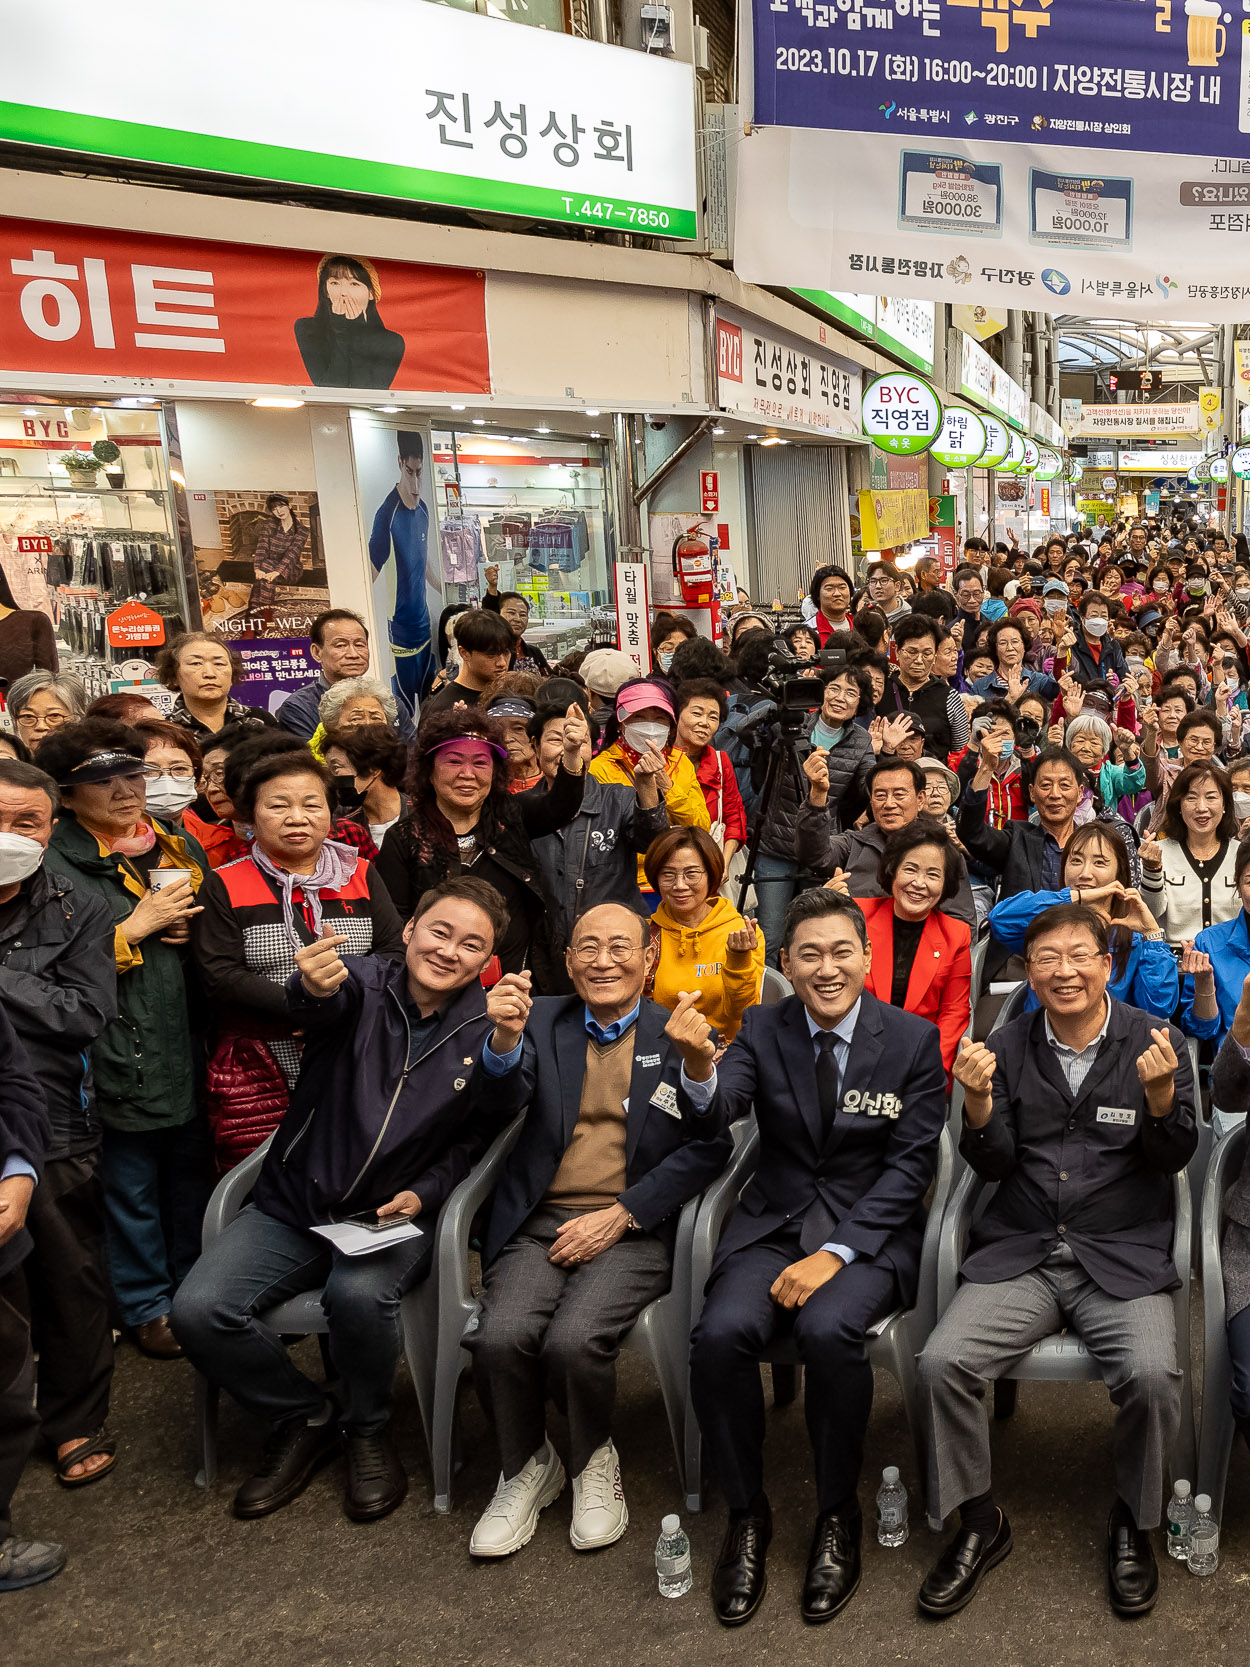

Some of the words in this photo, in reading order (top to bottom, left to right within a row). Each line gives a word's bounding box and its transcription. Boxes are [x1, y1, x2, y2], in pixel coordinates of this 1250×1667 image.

[776, 46, 879, 78] 2023.10.17
[884, 53, 919, 83] (화)
[924, 58, 1038, 90] 16:00~20:00
[1053, 64, 1194, 105] 자양전통시장
[1199, 75, 1222, 105] 내
[896, 107, 950, 124] 서울특별시
[983, 113, 1020, 126] 광진구
[424, 87, 636, 173] 진성상회
[560, 196, 670, 230] T.447-7850
[9, 248, 227, 356] 히트
[719, 329, 742, 377] BYC
[753, 338, 812, 400] 진성상회
[819, 364, 850, 412] 직영점
[879, 386, 920, 404] BYC
[23, 419, 69, 439] BYC
[871, 408, 929, 431] 직영점
[945, 415, 968, 430] 하림
[1092, 417, 1134, 426] 자양전통시장
[948, 430, 965, 449] 닭
[21, 538, 48, 551] BYC
[624, 570, 638, 605] 타월
[212, 618, 265, 632] NIGHT
[626, 612, 640, 646] 맞춤
[271, 658, 308, 671] 핑크퐁을
[843, 1089, 903, 1119] 오신환
